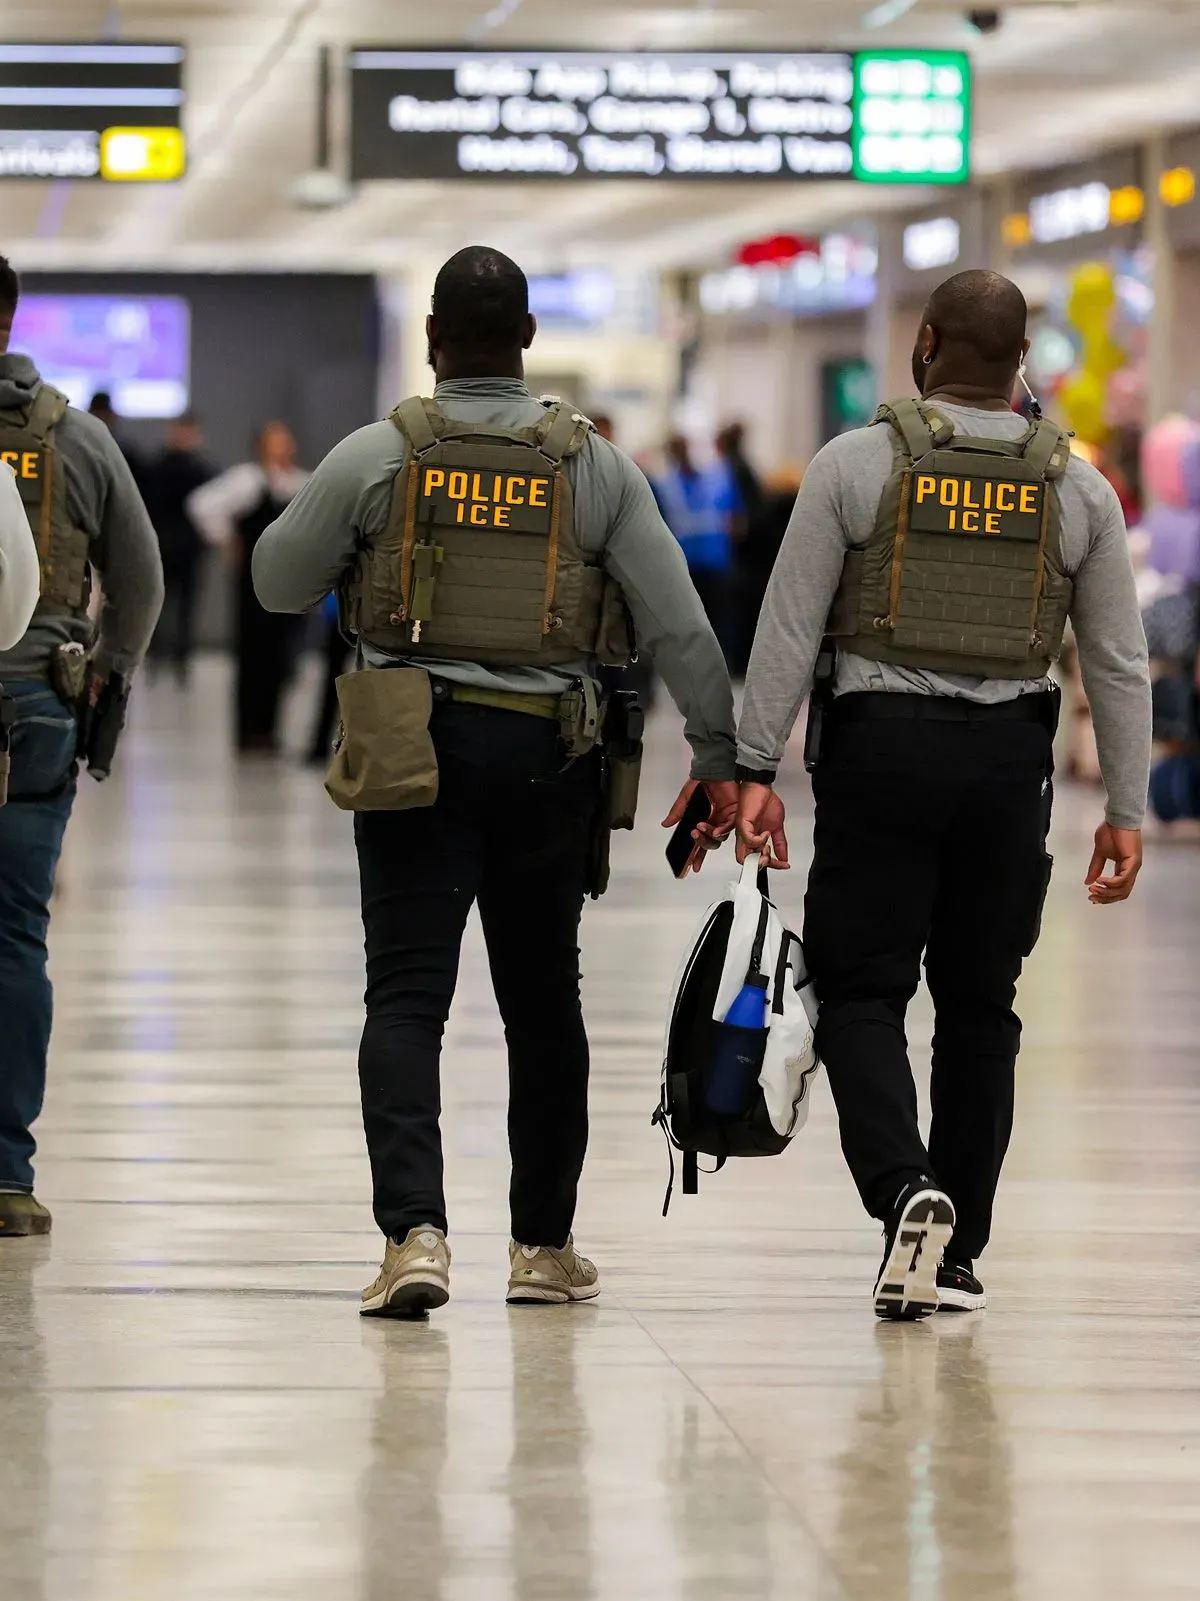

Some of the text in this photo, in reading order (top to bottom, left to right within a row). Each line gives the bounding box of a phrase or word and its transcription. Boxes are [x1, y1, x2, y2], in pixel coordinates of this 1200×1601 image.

[533, 60, 607, 103] App
[729, 60, 853, 103] Parking
[389, 95, 500, 132] Rental
[500, 95, 588, 135] Cars,
[588, 96, 710, 138] Garage
[748, 97, 853, 134] Metro
[458, 133, 578, 175] Hotels,
[666, 133, 782, 173] Shared
[783, 135, 853, 173] Van
[423, 469, 549, 507] POLICE
[916, 476, 1039, 513] POLICE
[456, 502, 511, 527] ICE
[948, 510, 1001, 534] ICE
